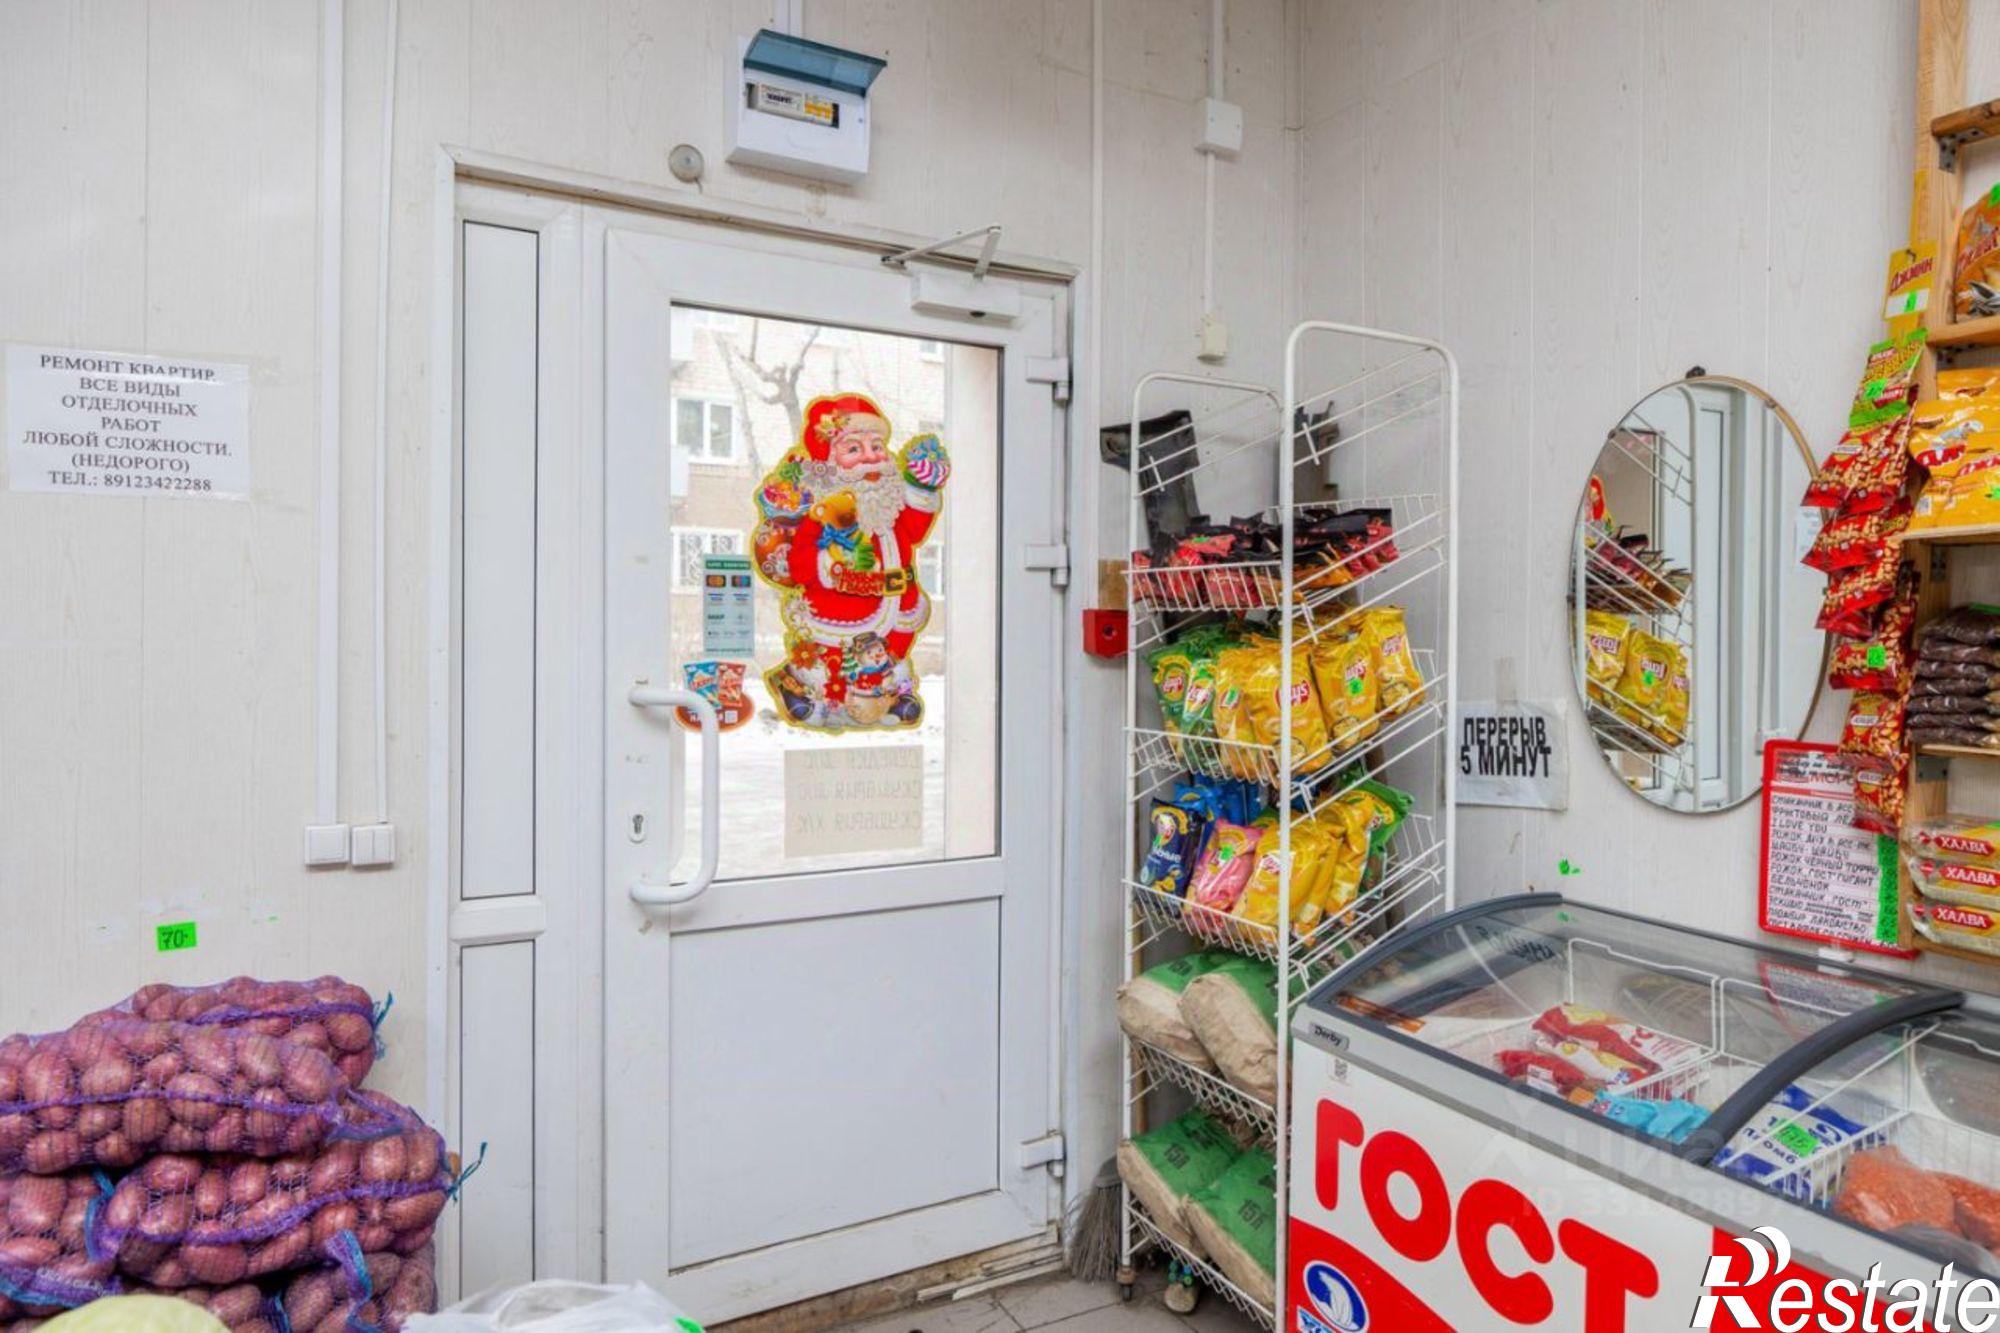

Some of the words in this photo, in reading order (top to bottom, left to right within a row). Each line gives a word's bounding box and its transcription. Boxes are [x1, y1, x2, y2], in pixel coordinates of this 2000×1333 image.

[40, 354, 124, 374] РЕМОНТ
[130, 363, 216, 381] КВАРТИР.
[80, 377, 118, 392] ВСЕ
[124, 381, 180, 398] ВИДЫ
[62, 395, 198, 417] ОТДЕЛОЧНЫХ
[101, 416, 161, 432] РАБОТ
[22, 431, 99, 447] ЛЮБОЙ
[105, 436, 232, 457] СЛОЖНОСТИ.
[71, 453, 190, 474] (НЕДОРОГО)
[47, 470, 98, 486] ТЕЛ.:
[104, 475, 212, 491] 89123422288
[1464, 717, 1546, 746] ПЕРЕРЫВ
[1461, 745, 1471, 775] 5
[1479, 745, 1551, 777] МИНУТ
[1778, 820, 1802, 830] LOVE
[1809, 823, 1827, 834] YOU
[1940, 836, 1989, 855] ХАЛВА
[1946, 866, 1996, 886] ХАЛВА
[1937, 907, 1987, 928] ХАЛВА
[1314, 1024, 1340, 1046] Derby
[1315, 1098, 1660, 1333] ГОСТ
